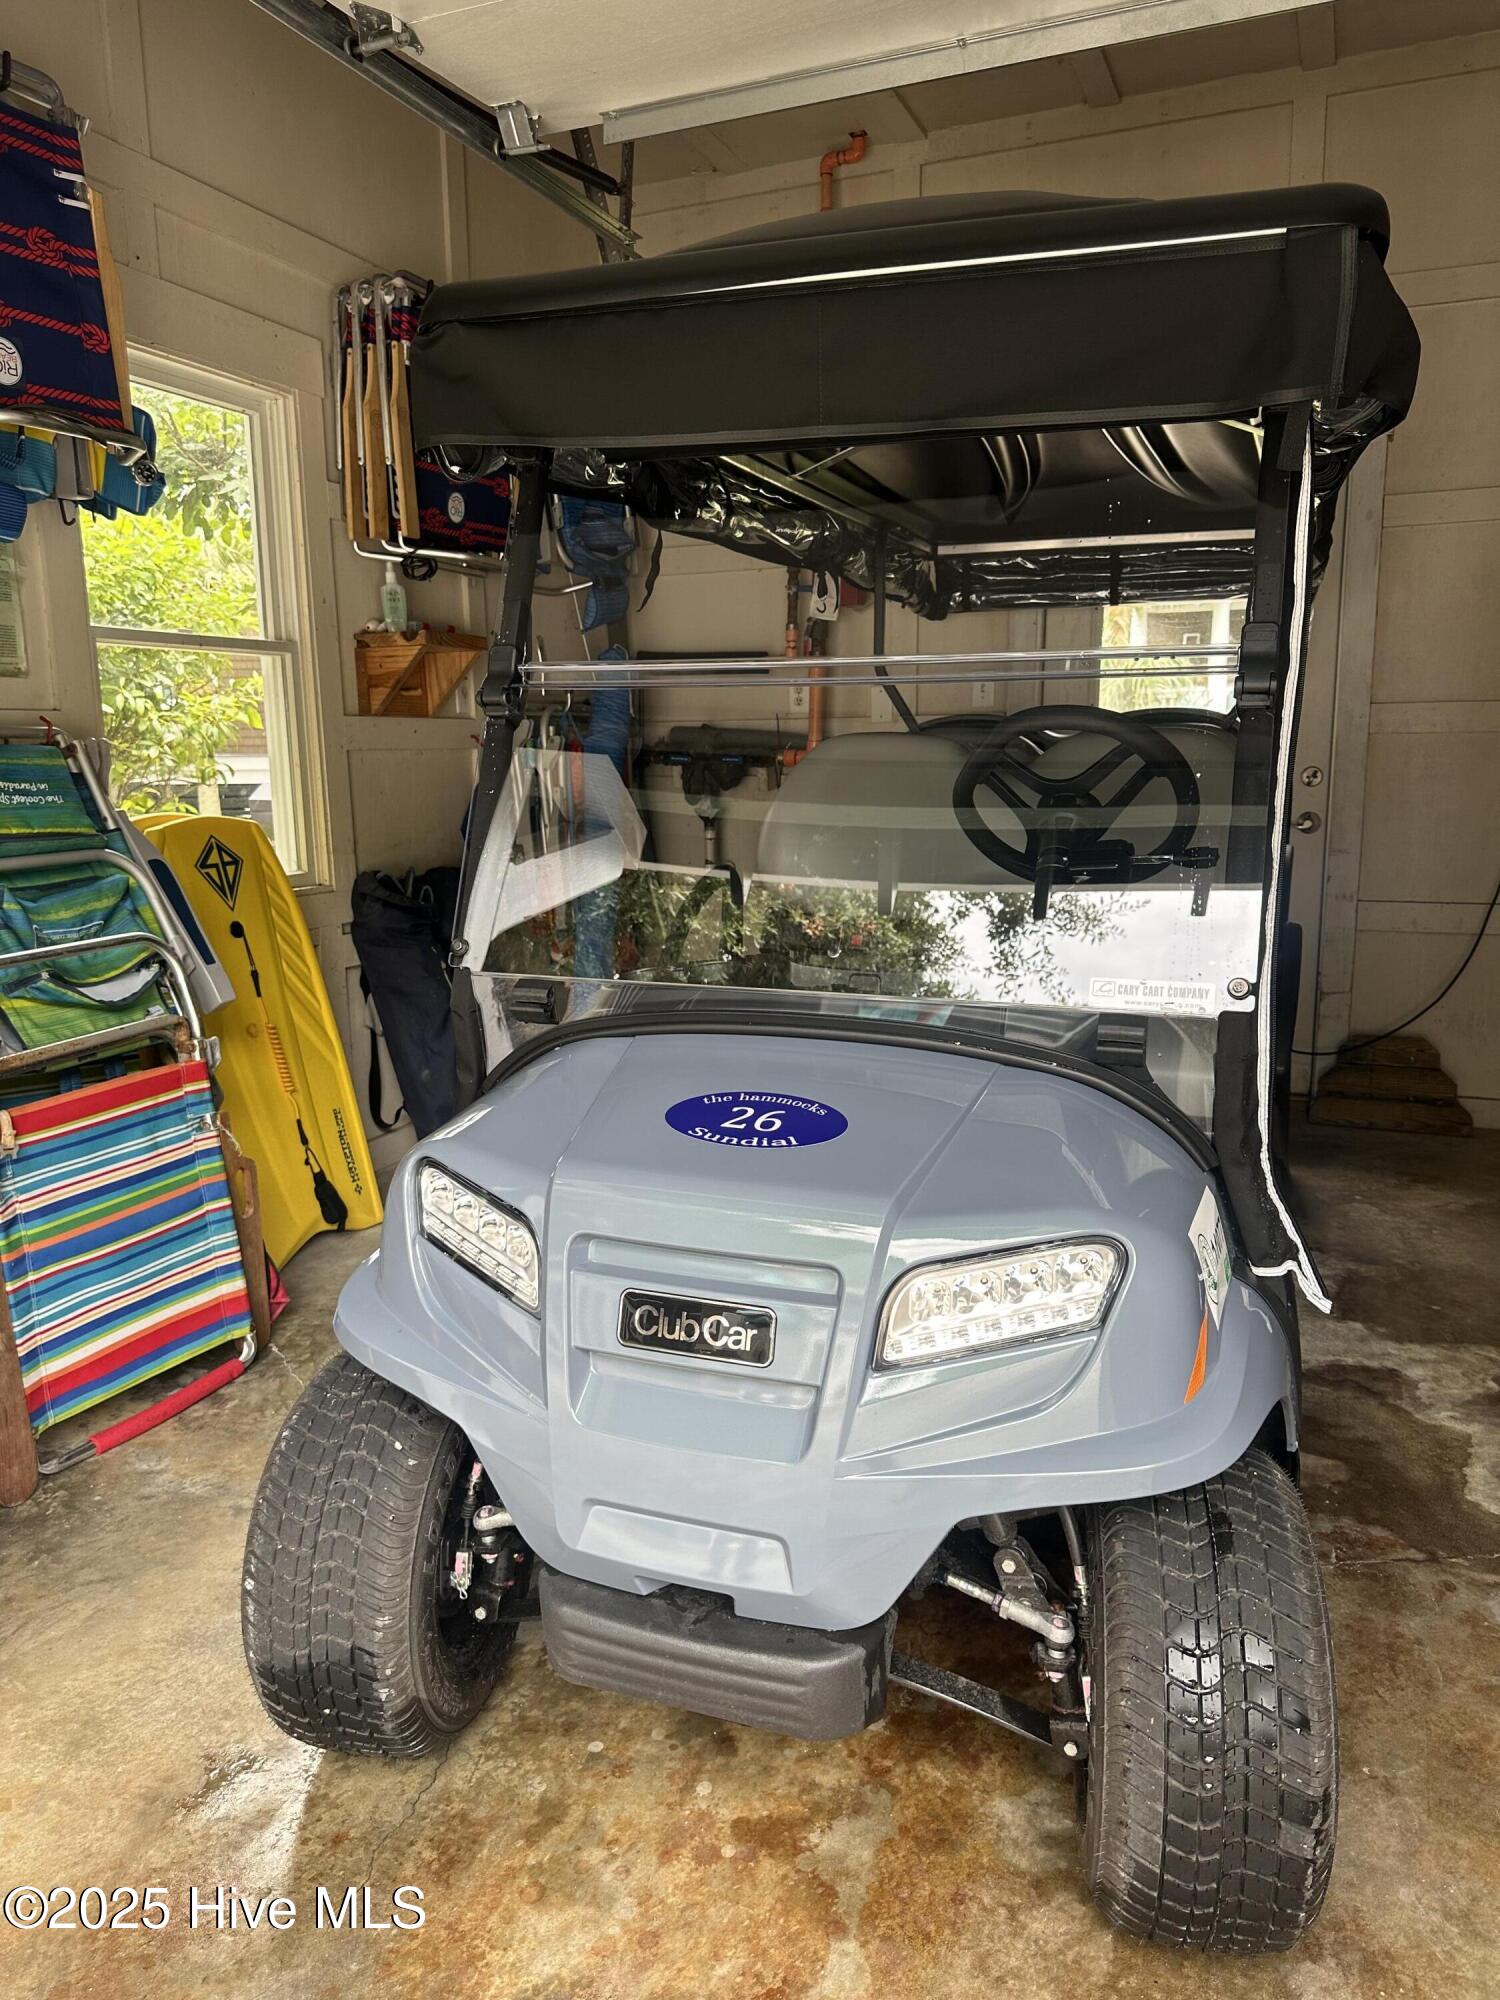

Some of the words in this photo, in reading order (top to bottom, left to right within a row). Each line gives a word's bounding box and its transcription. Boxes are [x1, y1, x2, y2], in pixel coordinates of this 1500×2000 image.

[11, 794, 46, 806] Coolest
[45, 794, 65, 804] The
[1117, 983, 1141, 996] CARY
[1142, 985, 1165, 998] CART
[1167, 985, 1210, 1000] COMPANY
[703, 1094, 733, 1105] the
[739, 1092, 828, 1116] hammocks
[720, 1106, 786, 1132] 26
[688, 1126, 800, 1147] Sundial
[634, 1304, 700, 1343] Club
[703, 1314, 758, 1351] Car
